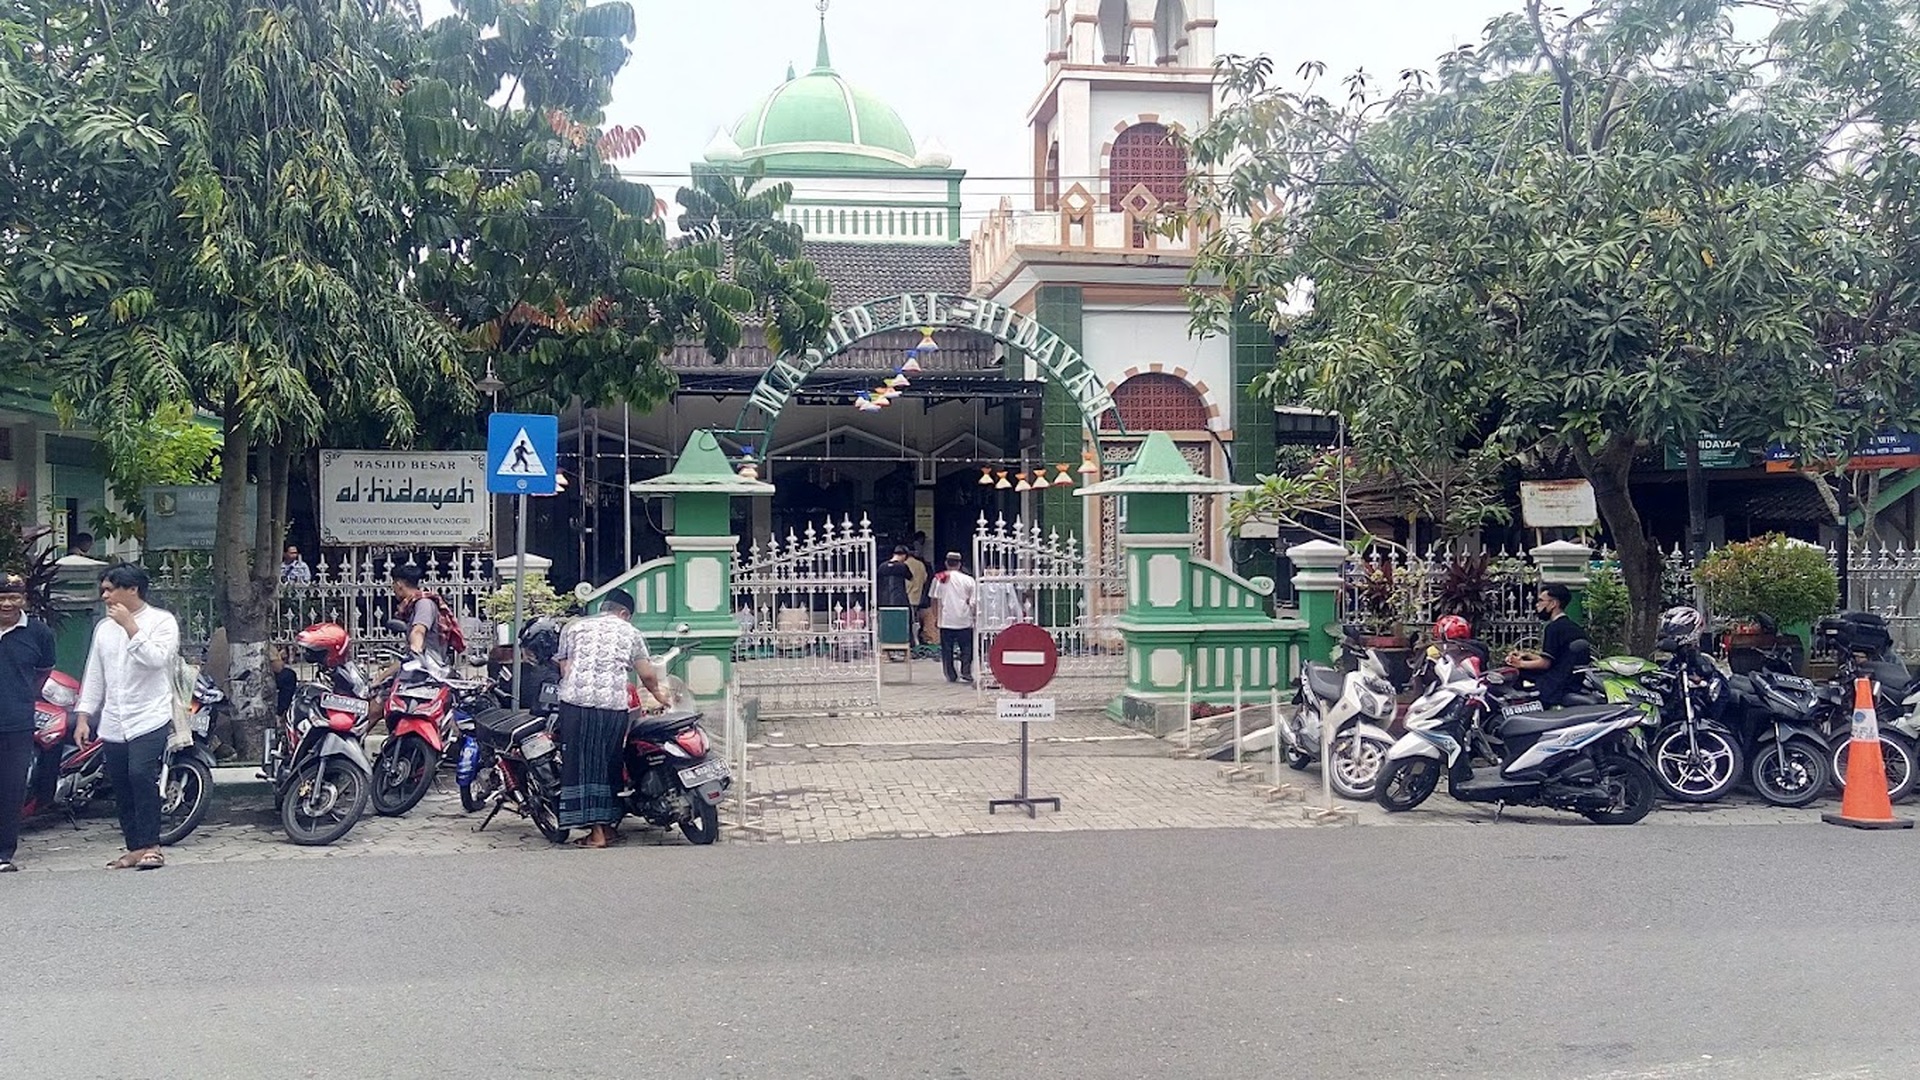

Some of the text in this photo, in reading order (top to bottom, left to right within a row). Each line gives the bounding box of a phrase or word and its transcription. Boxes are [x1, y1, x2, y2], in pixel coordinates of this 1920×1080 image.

[749, 292, 1117, 419] MASJID AL-HIDAYAH
[353, 460, 456, 470] MASJID BESAR
[339, 517, 387, 525] WONOKARTO
[388, 517, 432, 525] KECAMATAN
